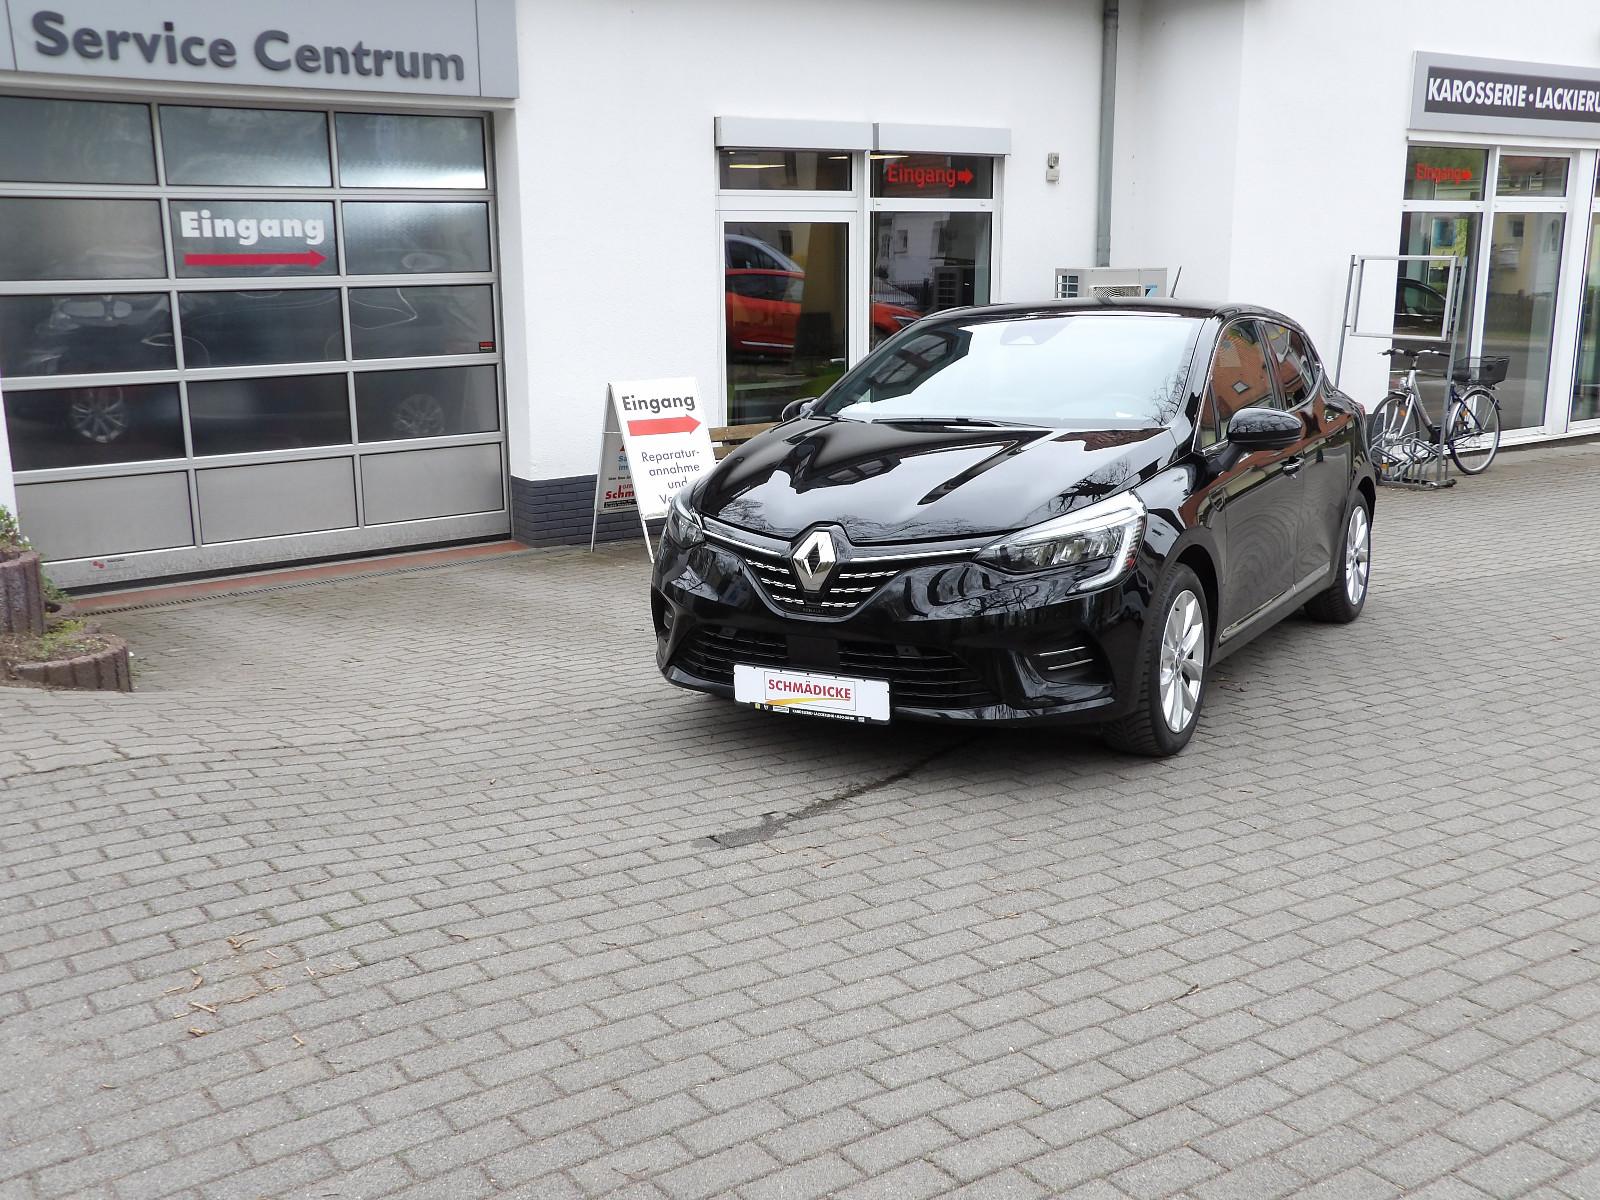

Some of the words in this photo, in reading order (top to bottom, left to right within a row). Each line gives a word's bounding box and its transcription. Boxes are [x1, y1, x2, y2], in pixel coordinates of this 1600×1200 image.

[31, 10, 237, 68] Service
[253, 29, 465, 81] Centrum
[1427, 77, 1527, 107] KAROSSERIE
[887, 163, 956, 187] Eingang
[1415, 162, 1461, 185] Eingang
[180, 210, 325, 246] Eingang
[622, 395, 696, 413] Eingang
[641, 450, 700, 464] Reparatur-
[649, 462, 700, 476] annahme
[667, 476, 688, 489] und
[768, 680, 851, 699] SCHMÄDICKE
